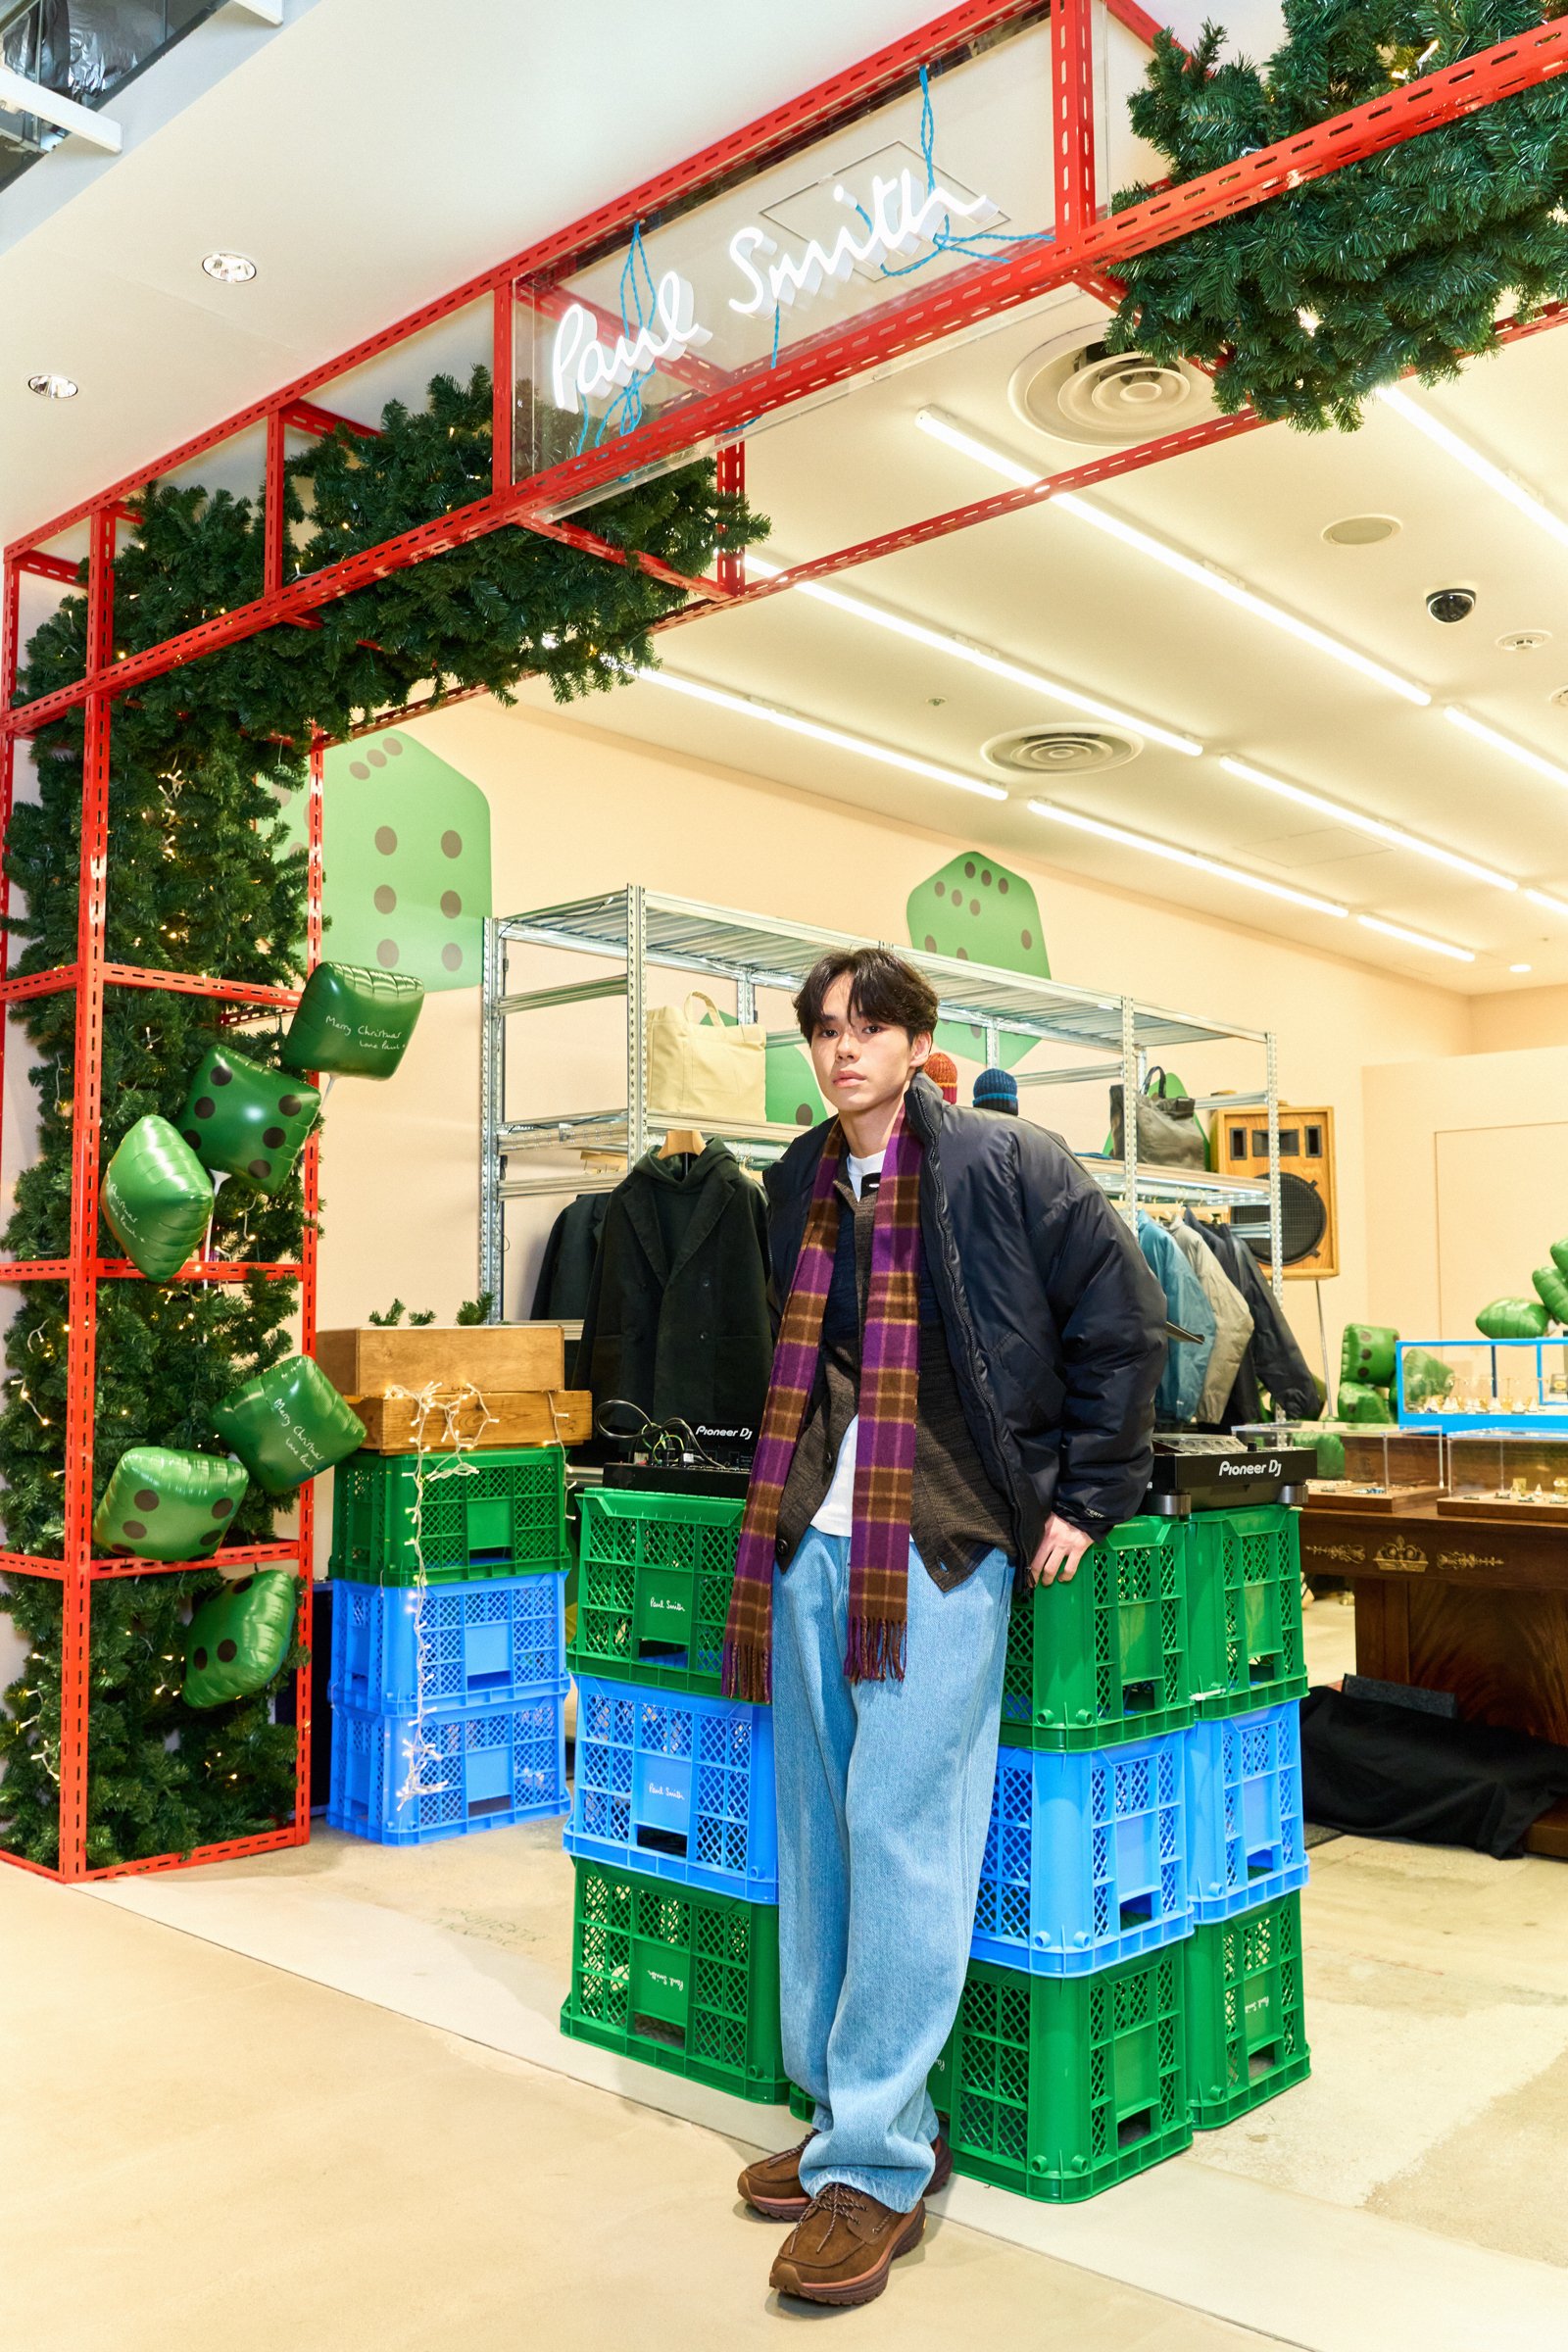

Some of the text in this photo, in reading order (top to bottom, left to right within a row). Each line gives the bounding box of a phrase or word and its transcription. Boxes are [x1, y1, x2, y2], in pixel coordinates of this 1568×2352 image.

[552, 168, 990, 413] Paul Smith
[325, 1015, 351, 1036] Merry
[273, 1397, 290, 1427] Merry
[695, 1425, 738, 1437] Pioneer
[1218, 1460, 1267, 1477] Pioneer
[650, 1596, 664, 1608] Paul
[649, 1782, 663, 1794] Paul
